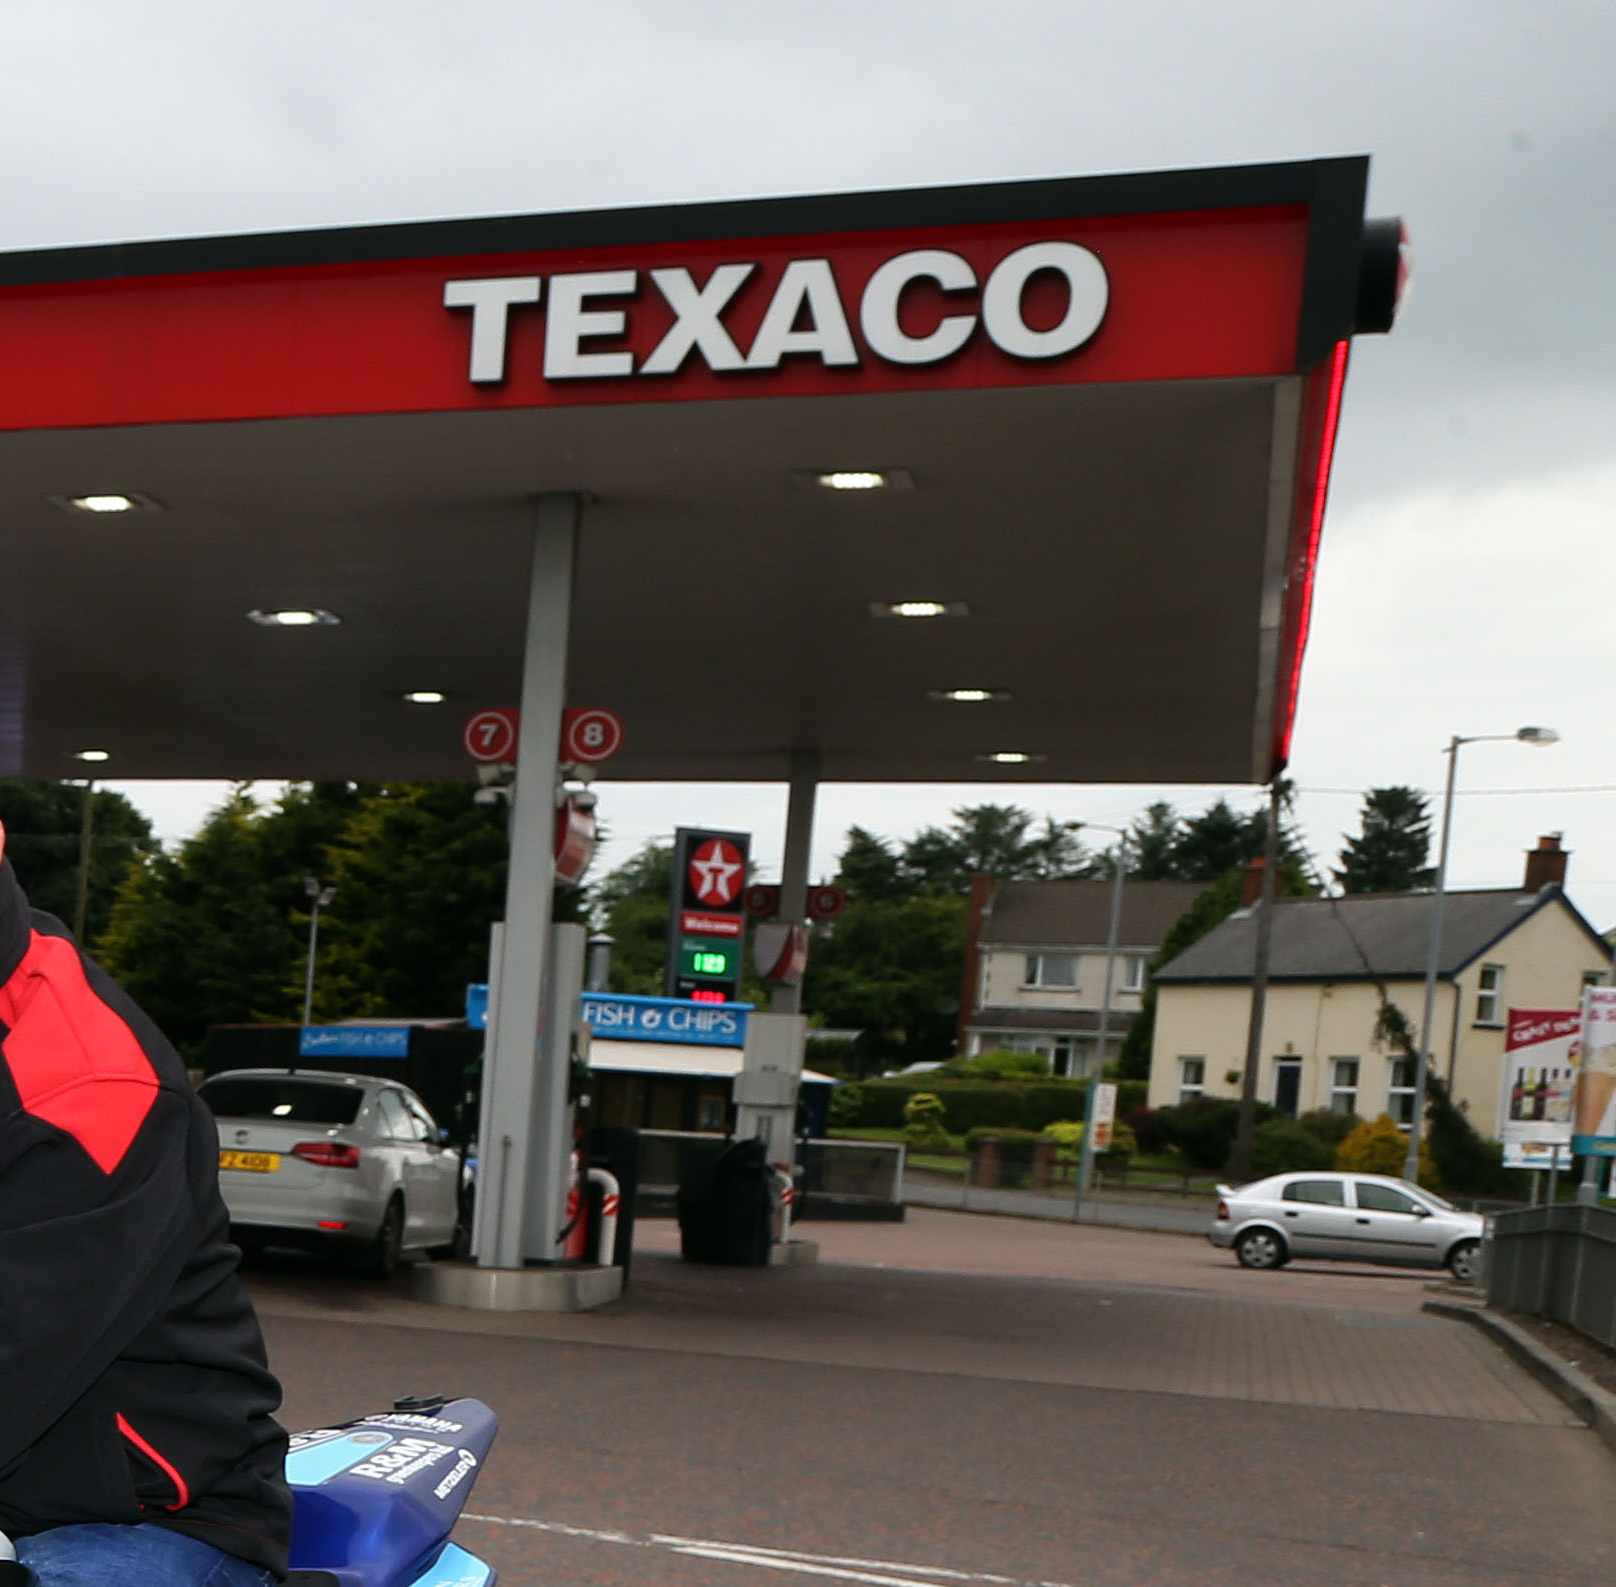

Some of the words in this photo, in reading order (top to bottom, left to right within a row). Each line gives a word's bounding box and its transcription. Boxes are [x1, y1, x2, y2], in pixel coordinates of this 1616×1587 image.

[444, 241, 1110, 384] TEXACO
[478, 723, 500, 748] 7
[583, 723, 605, 748] 8
[583, 1003, 635, 1027] FISH
[669, 1006, 738, 1034] CHIPS
[349, 1437, 436, 1479] R&M
